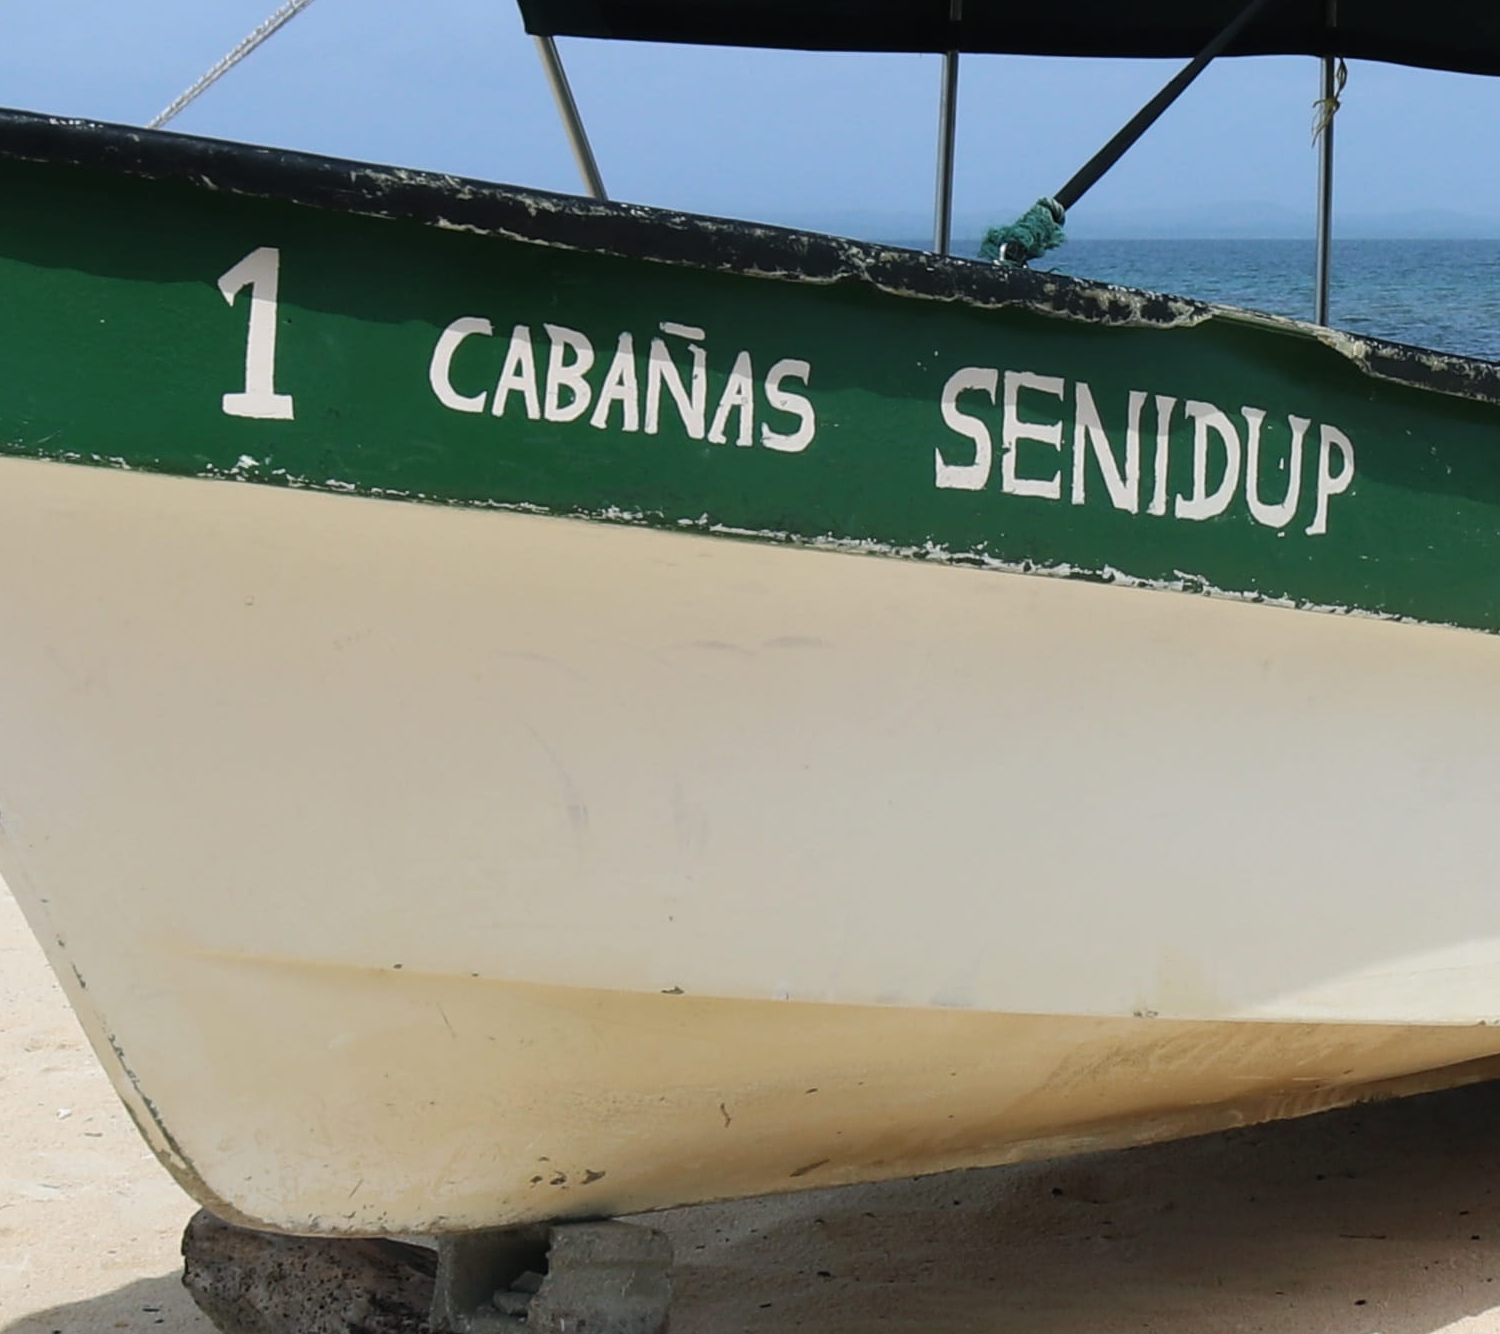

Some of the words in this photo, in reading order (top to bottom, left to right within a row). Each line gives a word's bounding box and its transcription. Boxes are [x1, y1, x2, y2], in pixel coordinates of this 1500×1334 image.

[215, 245, 296, 423] 1
[428, 315, 817, 454] CABAÑAS
[934, 367, 1356, 536] SENIDUP
